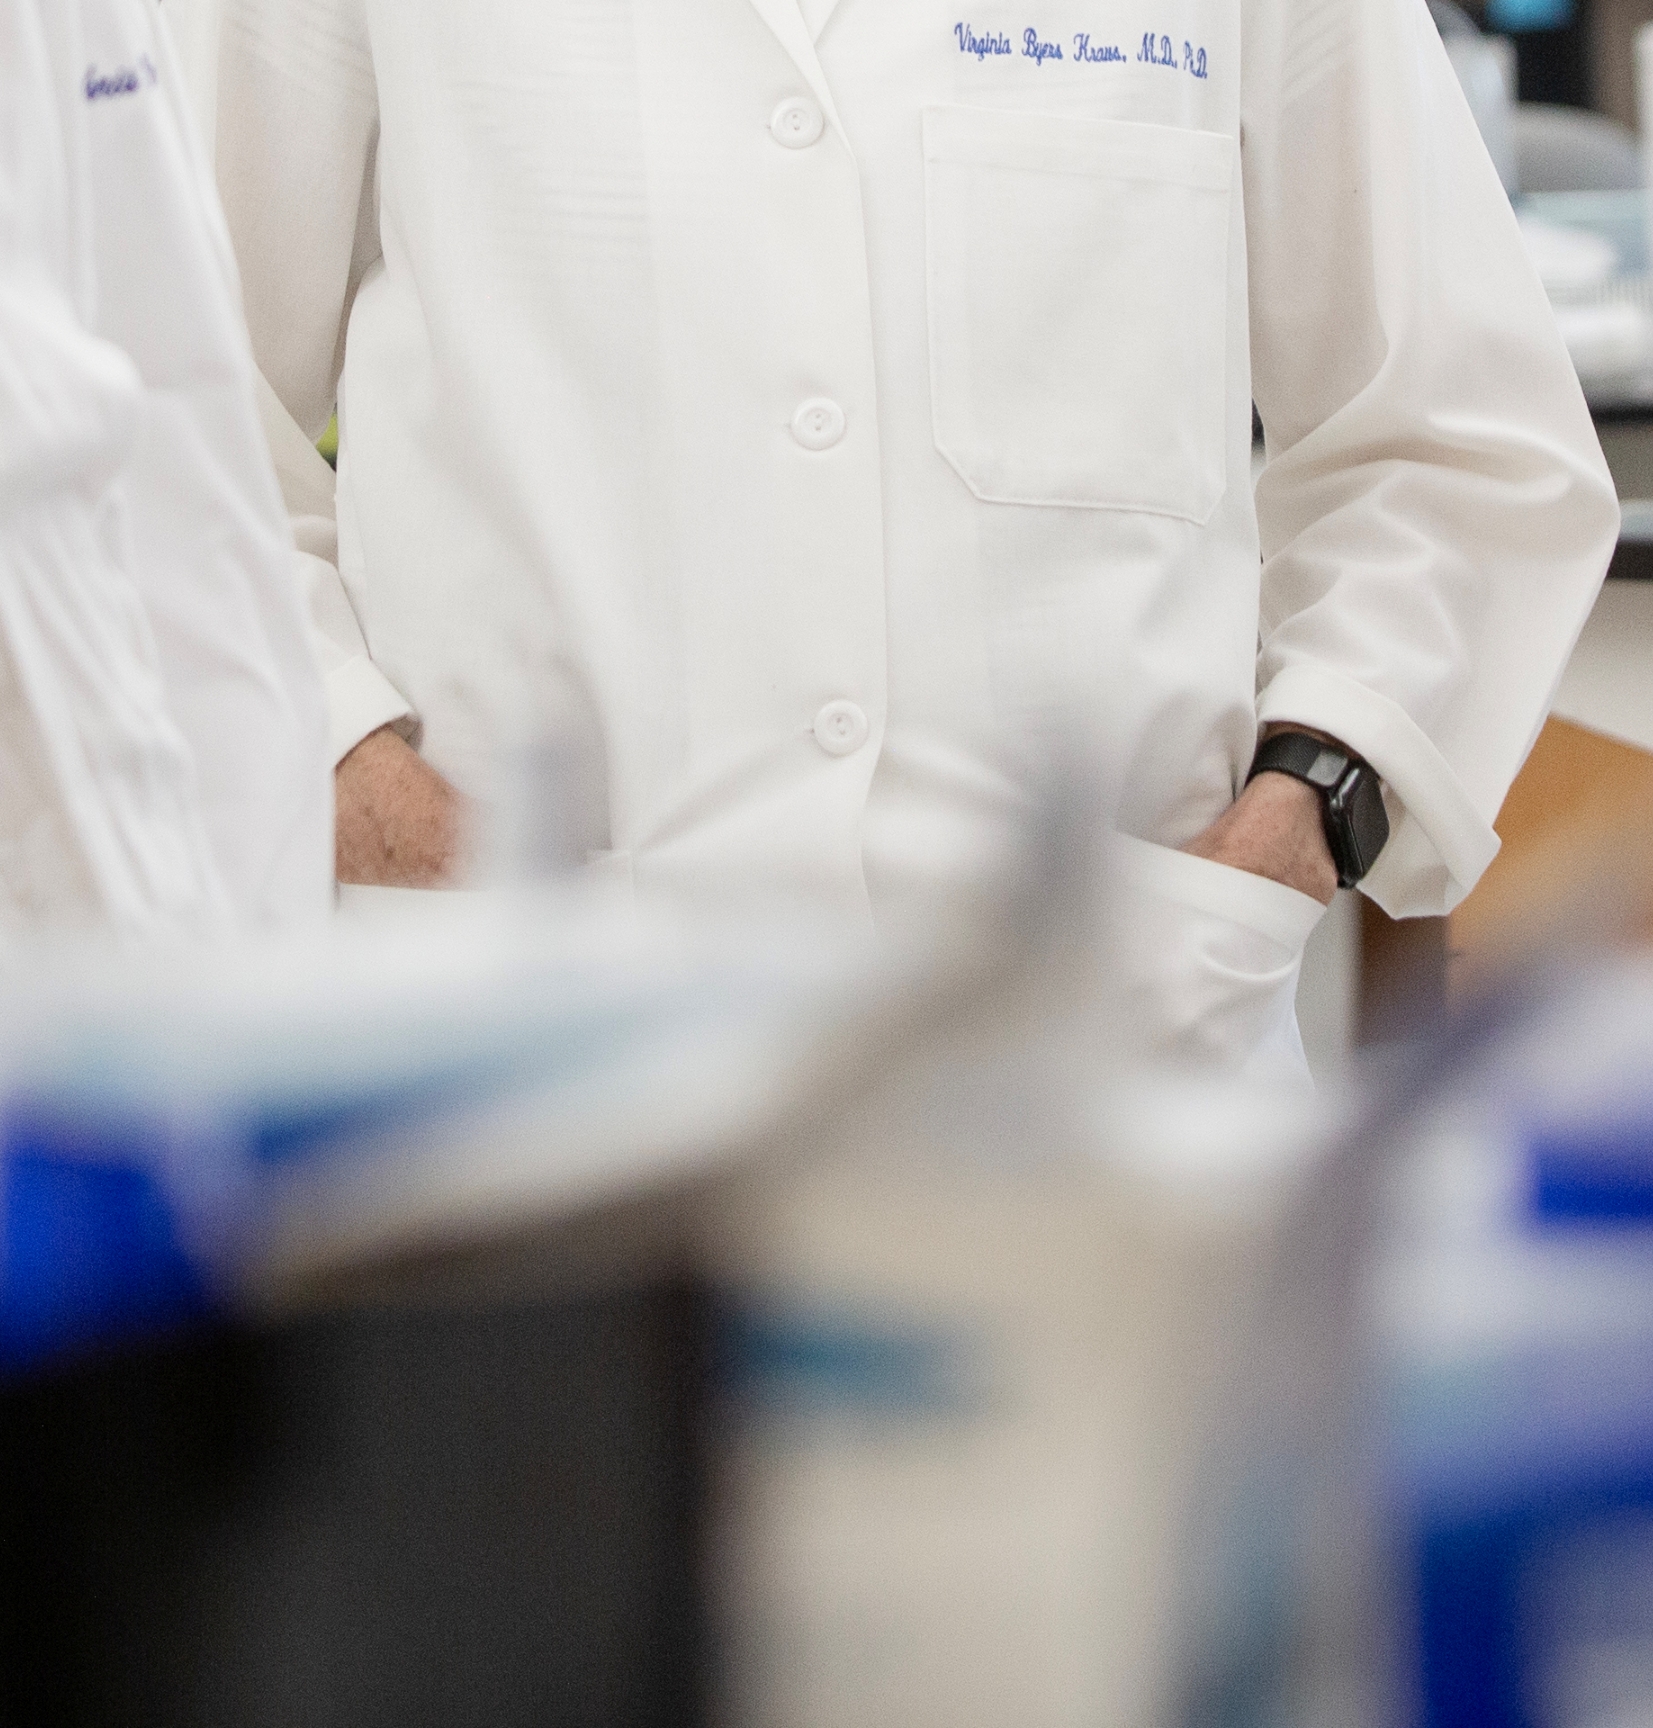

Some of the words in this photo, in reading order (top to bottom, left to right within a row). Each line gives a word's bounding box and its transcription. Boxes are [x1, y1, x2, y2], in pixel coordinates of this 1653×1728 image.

[954, 22, 1012, 62] Virginia
[1021, 27, 1063, 67] Byers
[1073, 33, 1126, 63] Kraus,
